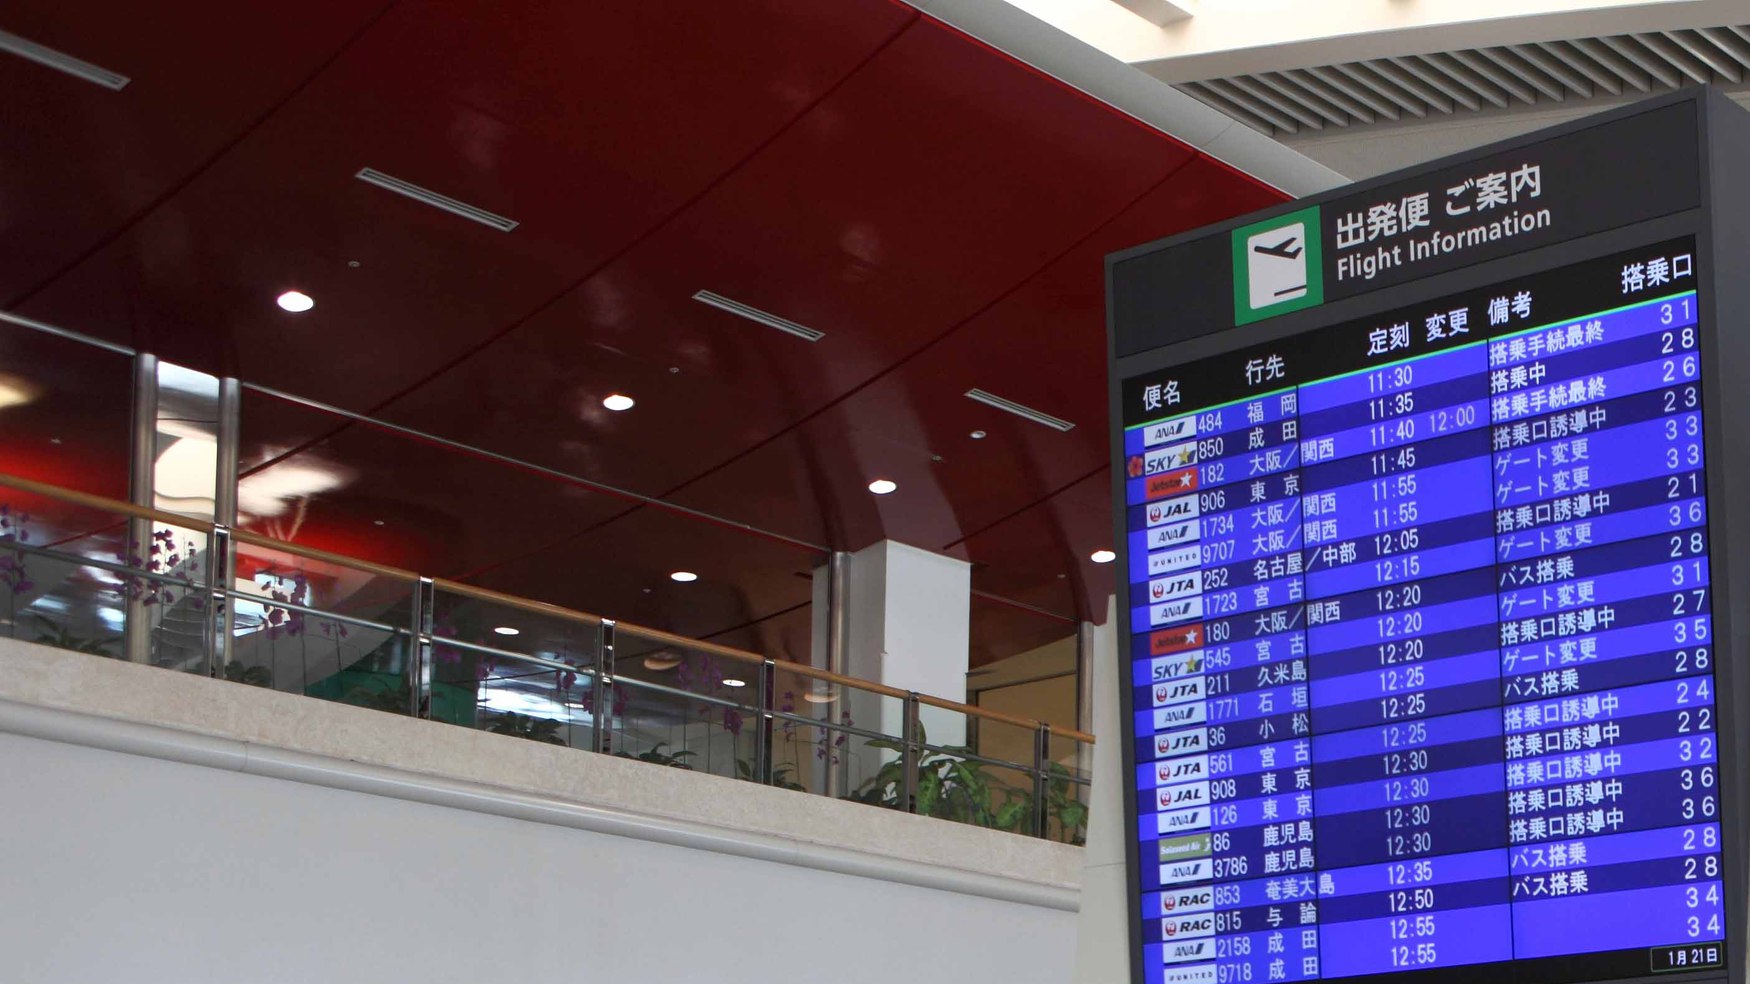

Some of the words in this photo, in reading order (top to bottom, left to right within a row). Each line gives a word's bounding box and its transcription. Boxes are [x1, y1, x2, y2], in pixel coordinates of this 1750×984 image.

[1336, 194, 1430, 250] 出発便
[1446, 165, 1541, 215] ご案内
[1337, 244, 1402, 282] Flight
[1410, 206, 1551, 262] Information
[1143, 380, 1181, 411] 便名
[1246, 356, 1284, 387] 行先
[1368, 324, 1411, 356] 定刻
[1426, 307, 1469, 340] 変更
[1488, 290, 1532, 326] 備考
[1622, 253, 1694, 296] 搭乗口
[1198, 412, 1222, 433] 484
[1368, 365, 1413, 393] 11:30
[1199, 437, 1224, 460] 850
[1369, 392, 1414, 419] 11:35
[1200, 464, 1224, 485] 182
[1370, 419, 1415, 446] 11:40
[1430, 406, 1475, 434] 12:00
[1163, 503, 1191, 518] JAL
[1200, 491, 1225, 512] 906
[1371, 447, 1416, 475] 11:45
[1202, 514, 1234, 537] 1734
[1373, 474, 1416, 501] 11:55
[1203, 540, 1235, 563] 9707
[1374, 501, 1418, 528] 11:55
[1203, 568, 1228, 590] 252
[1375, 528, 1419, 555] 12:05
[1205, 592, 1237, 615] 1723
[1376, 555, 1420, 582] 12:15
[1206, 622, 1230, 643] 180
[1377, 585, 1421, 611] 12:20
[1206, 647, 1231, 669] 545
[1378, 612, 1422, 638] 12:20
[1207, 673, 1230, 695] 211
[1379, 639, 1423, 665] 12:20
[1208, 698, 1239, 722] 1771
[1380, 665, 1424, 692] 12:25
[1208, 726, 1226, 746] 36
[1381, 693, 1425, 719] 12:25
[1174, 787, 1202, 803] JAL
[1211, 779, 1236, 801] 908
[1383, 750, 1428, 775] 12:30
[1209, 754, 1233, 775] 561
[1382, 723, 1427, 748] 12:25
[1213, 805, 1237, 826] 126
[1384, 777, 1429, 802] 12:30
[1213, 832, 1230, 851] 86
[1385, 804, 1430, 830] 12:30
[1214, 856, 1248, 878] 3786
[1386, 832, 1431, 857] 12:30
[1215, 885, 1240, 905] 853
[1387, 859, 1432, 885] 12:35
[1216, 911, 1241, 931] 815
[1389, 887, 1433, 912] 12:50
[1217, 936, 1250, 958] 2158
[1390, 915, 1434, 940] 12:55
[1219, 963, 1252, 984] 9718
[1391, 942, 1435, 967] 12:55
